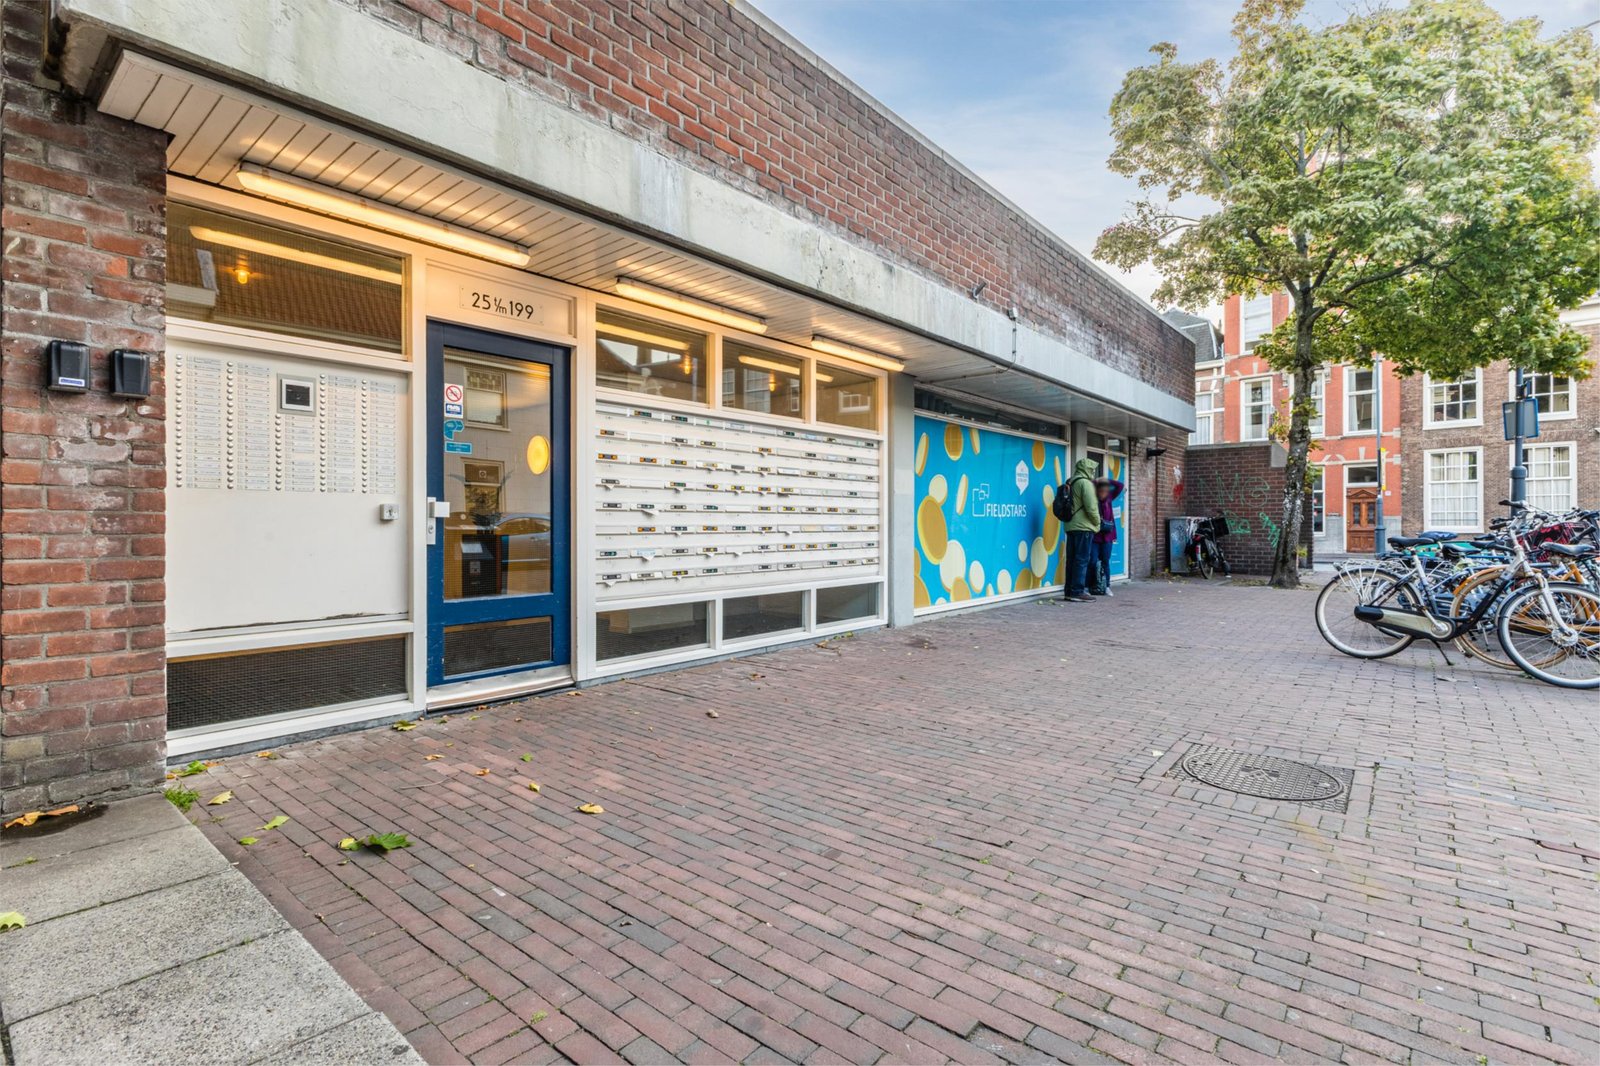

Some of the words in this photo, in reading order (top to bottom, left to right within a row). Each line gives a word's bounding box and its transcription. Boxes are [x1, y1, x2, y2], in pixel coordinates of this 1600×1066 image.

[472, 292, 491, 310] 25
[509, 301, 534, 319] 199
[986, 503, 1027, 517] FIELDSTARS
